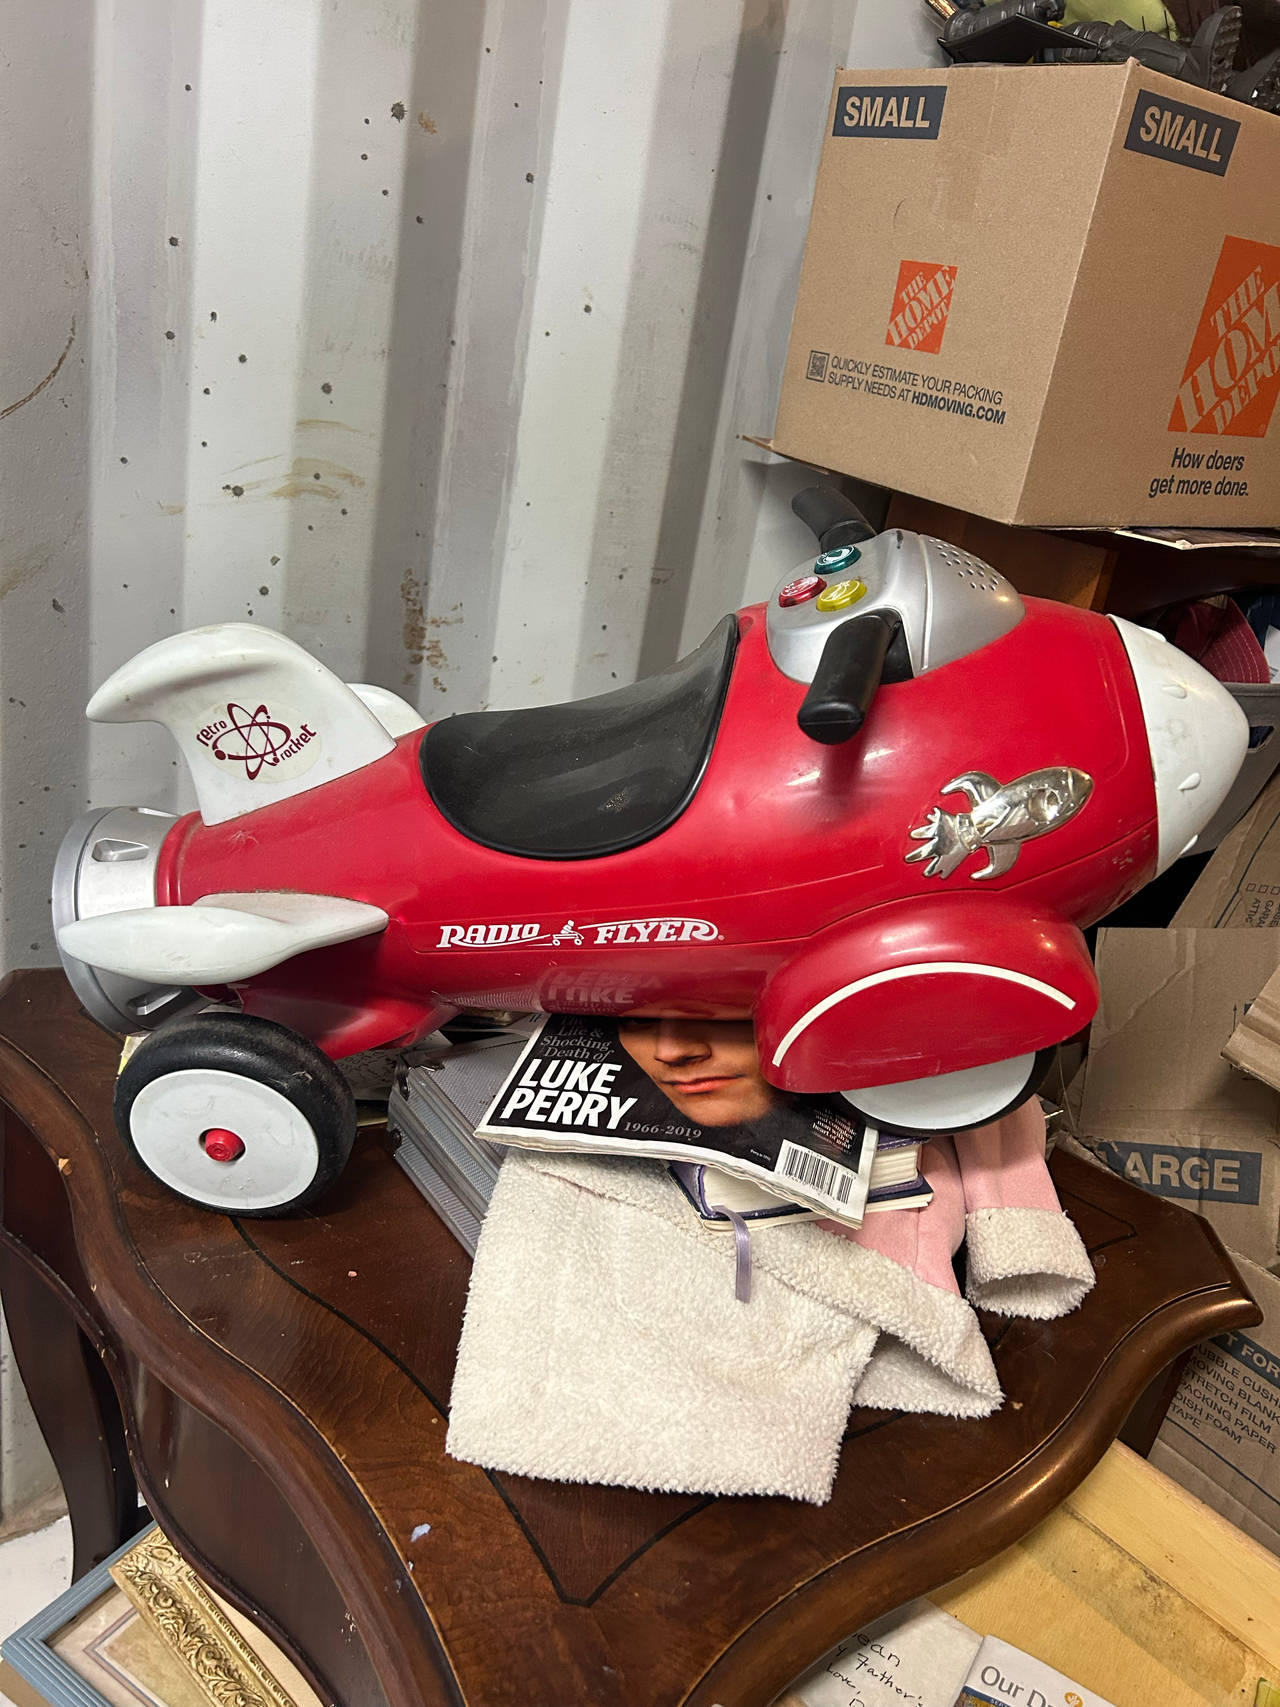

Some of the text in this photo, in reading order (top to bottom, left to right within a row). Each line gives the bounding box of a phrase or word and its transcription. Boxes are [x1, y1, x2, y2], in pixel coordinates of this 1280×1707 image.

[843, 96, 931, 129] SMALL
[1139, 105, 1223, 162] SMALL
[900, 271, 927, 304] THE
[1209, 264, 1265, 338] THE
[887, 266, 955, 346] HOME
[907, 299, 949, 350] DEPOT
[1178, 280, 1280, 433] HOM
[831, 354, 1004, 406] QUICKLY ESTIMATE YOUR PACKING
[1212, 343, 1280, 434] DEPO
[828, 372, 1006, 425] SUPPLY NEEDS AT HDMOVING.COM
[1170, 446, 1245, 472] How doers
[1149, 475, 1249, 499] get more done.
[196, 720, 227, 747] retro
[280, 724, 317, 760] rocket
[436, 918, 719, 948] RADIO FLYER
[540, 1035, 613, 1051] Shocking
[544, 1046, 615, 1062] Death of
[518, 1059, 622, 1094] LUKE
[499, 1087, 639, 1130] PERRY
[624, 1121, 702, 1138] 1966-2019
[1100, 1151, 1241, 1192] ARGE
[1196, 1344, 1240, 1379] UBBLE
[1170, 1402, 1201, 1429] TAPE
[1238, 1388, 1280, 1425] BLANK
[1240, 1406, 1271, 1434] FILM
[1205, 1413, 1242, 1444] FOAM
[1234, 1418, 1277, 1454] PAPER
[981, 1665, 1025, 1698] Our
